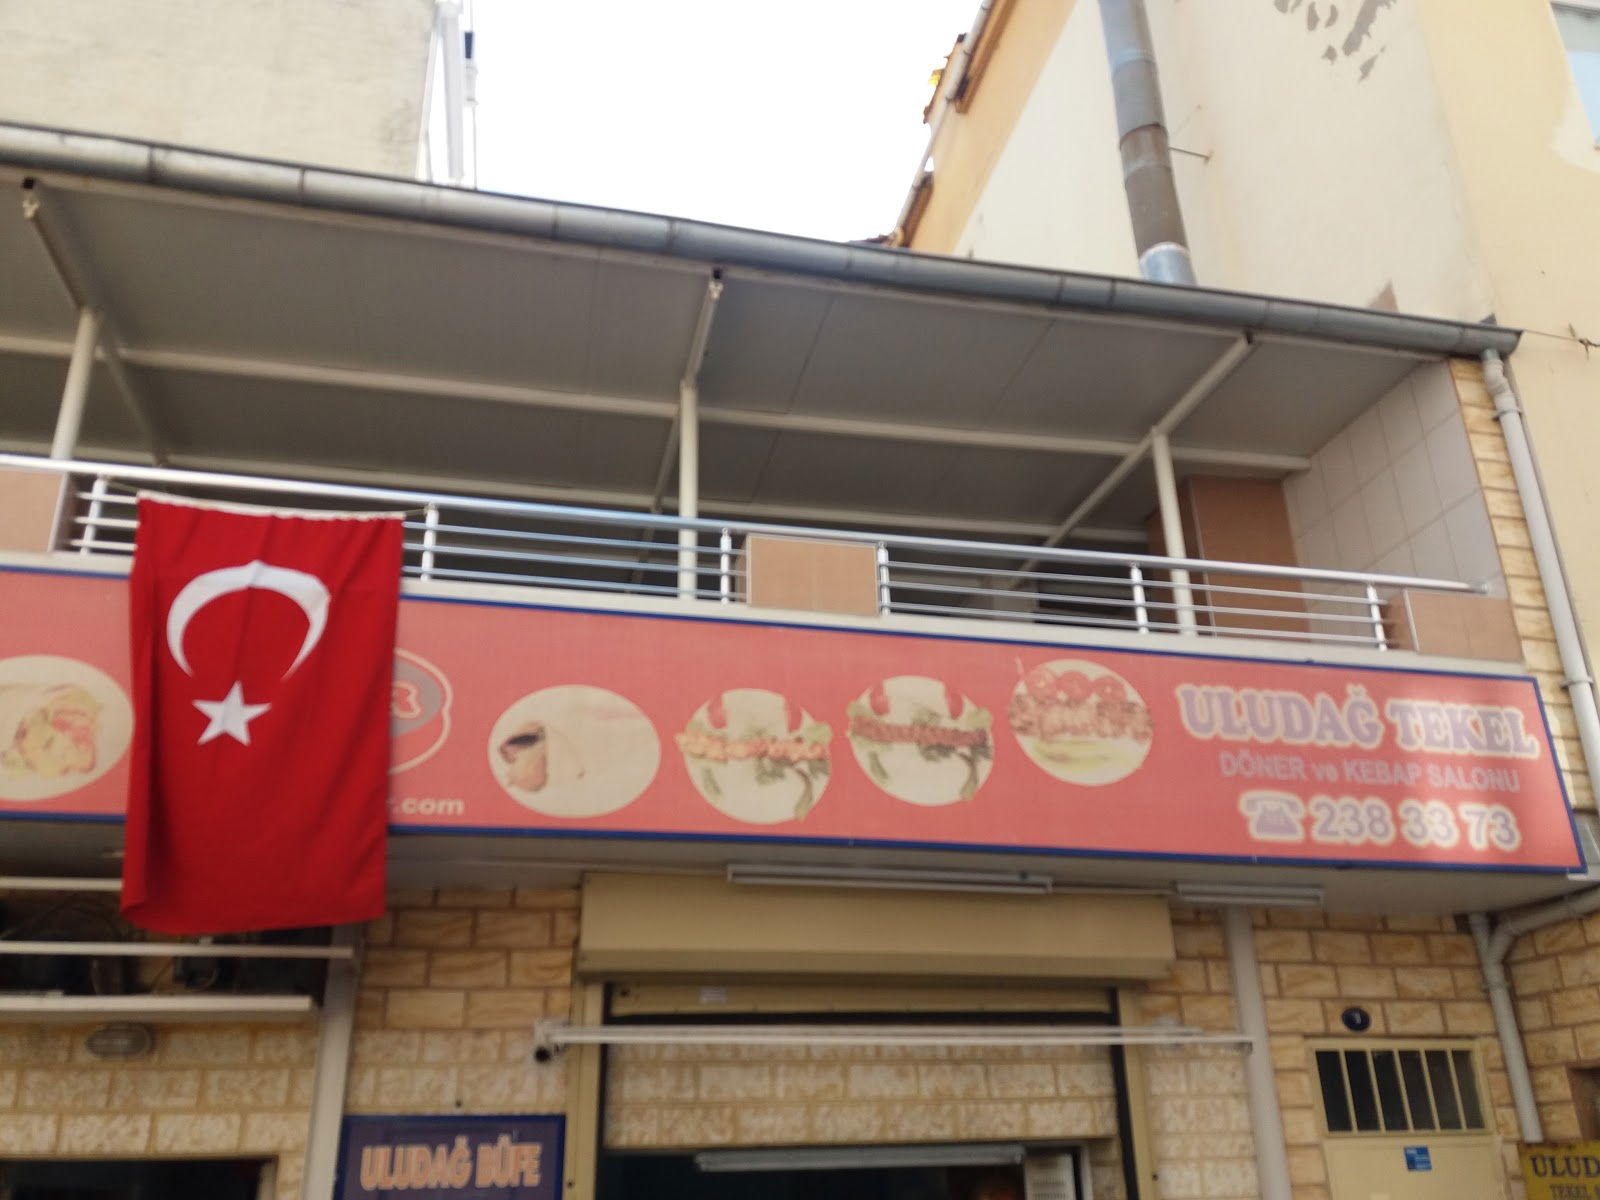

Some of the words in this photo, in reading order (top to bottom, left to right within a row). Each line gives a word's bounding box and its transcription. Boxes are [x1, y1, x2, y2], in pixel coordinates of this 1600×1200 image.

[1175, 683, 1384, 750] ULUDAĞ
[1385, 699, 1540, 759] TEKEL
[1219, 749, 1305, 780] DÖNER
[1343, 762, 1422, 787] KEBAP
[1426, 764, 1521, 793] SALONU
[1310, 794, 1397, 845] 238
[1399, 799, 1460, 847] 33
[1458, 803, 1523, 851] 73
[360, 1135, 472, 1192] ULUDAĞ
[475, 1133, 543, 1188] BÜFE
